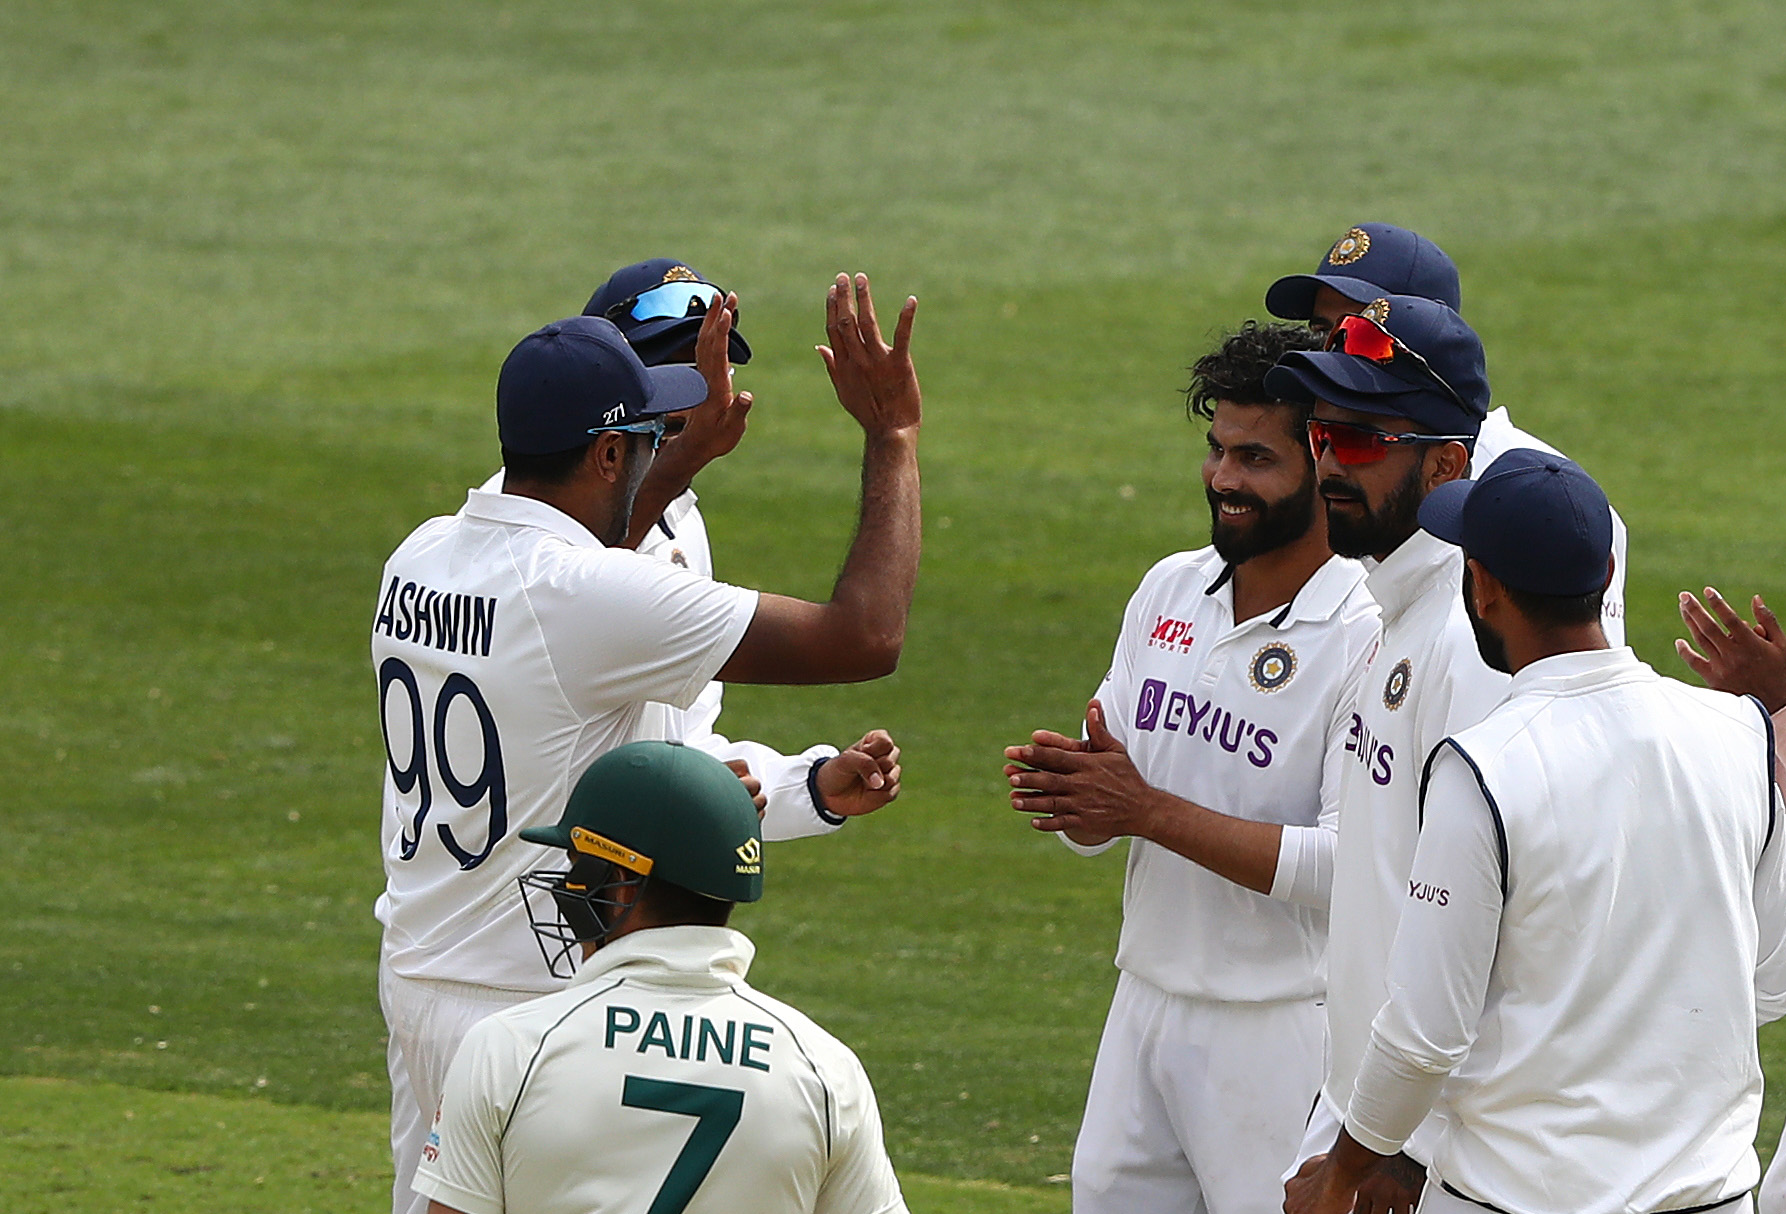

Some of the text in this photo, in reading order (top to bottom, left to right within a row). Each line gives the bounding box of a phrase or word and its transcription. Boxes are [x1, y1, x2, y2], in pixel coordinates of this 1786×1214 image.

[603, 402, 625, 425] 271
[375, 575, 498, 657] ASHWIN
[379, 657, 508, 870] 99
[1163, 690, 1279, 768] BYJU'S
[584, 835, 626, 858] MASURI
[603, 1005, 775, 1073] PAINE
